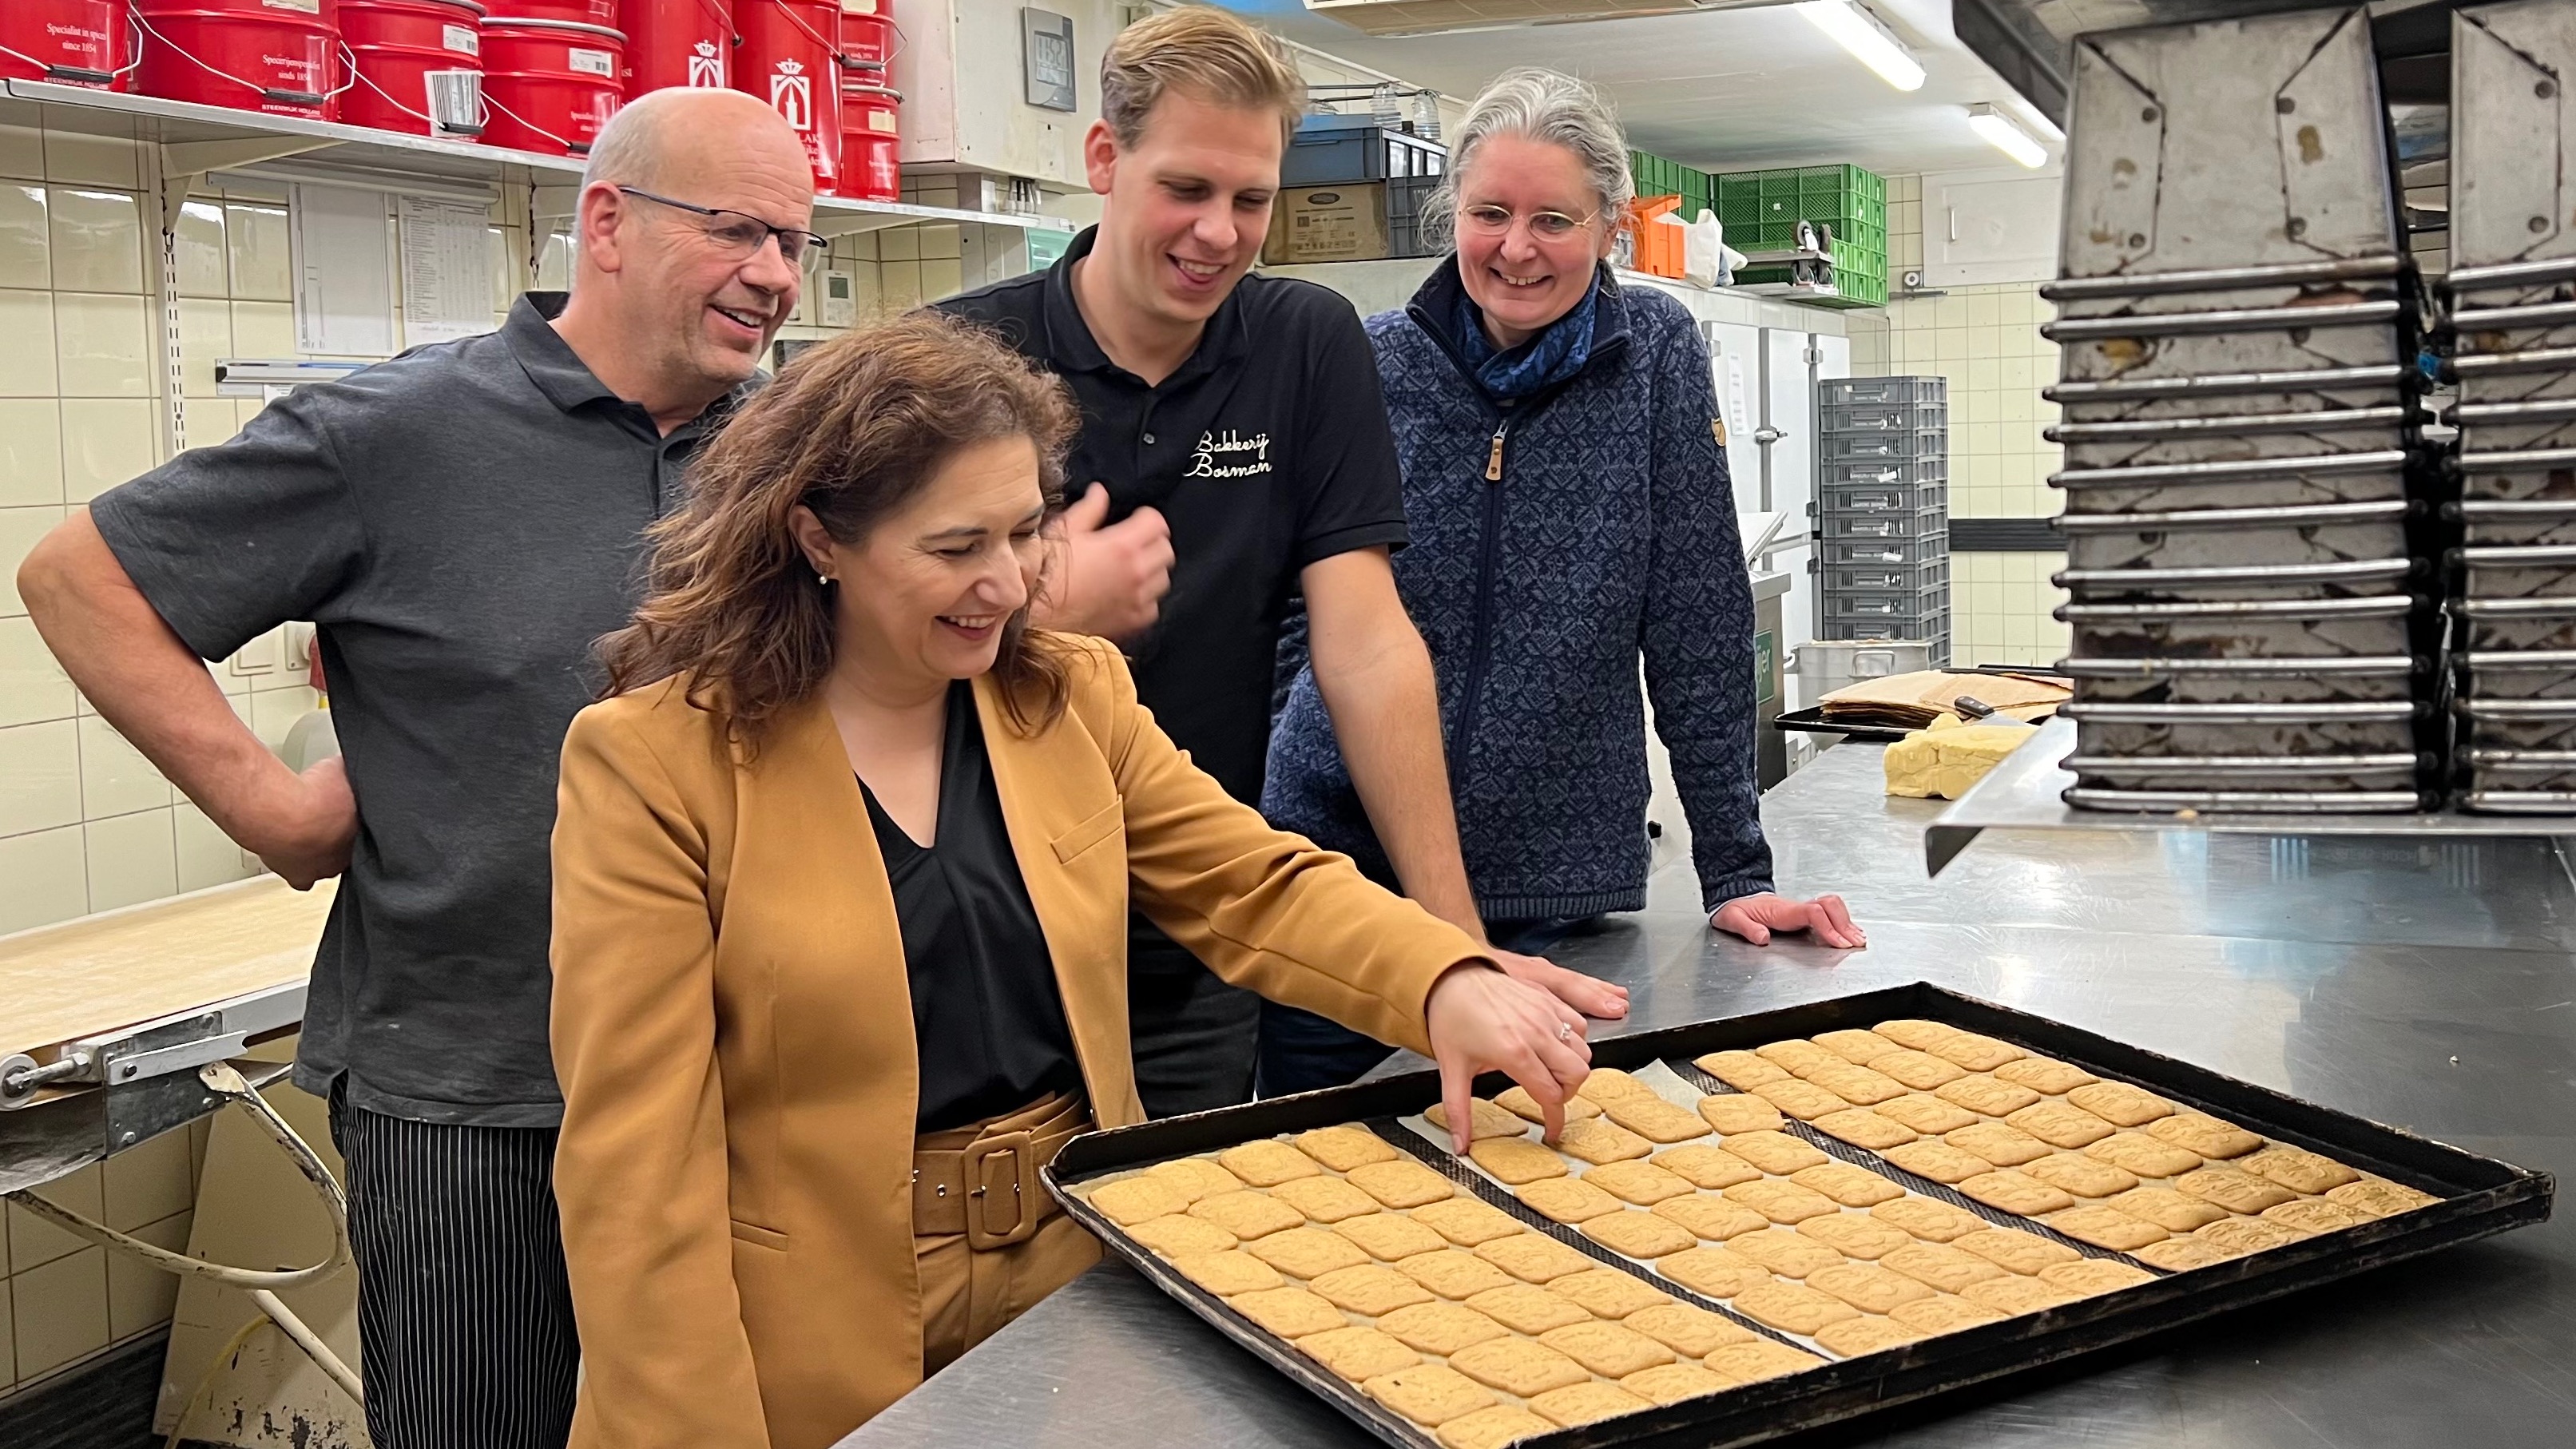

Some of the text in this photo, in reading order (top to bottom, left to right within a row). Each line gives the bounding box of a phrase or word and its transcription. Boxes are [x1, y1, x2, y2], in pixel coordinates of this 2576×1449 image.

[46, 22, 81, 36] Specialist
[81, 27, 89, 38] in
[62, 40, 80, 50] since
[1195, 429, 1270, 460] Bakkerij
[1183, 452, 1272, 478] Bosman
